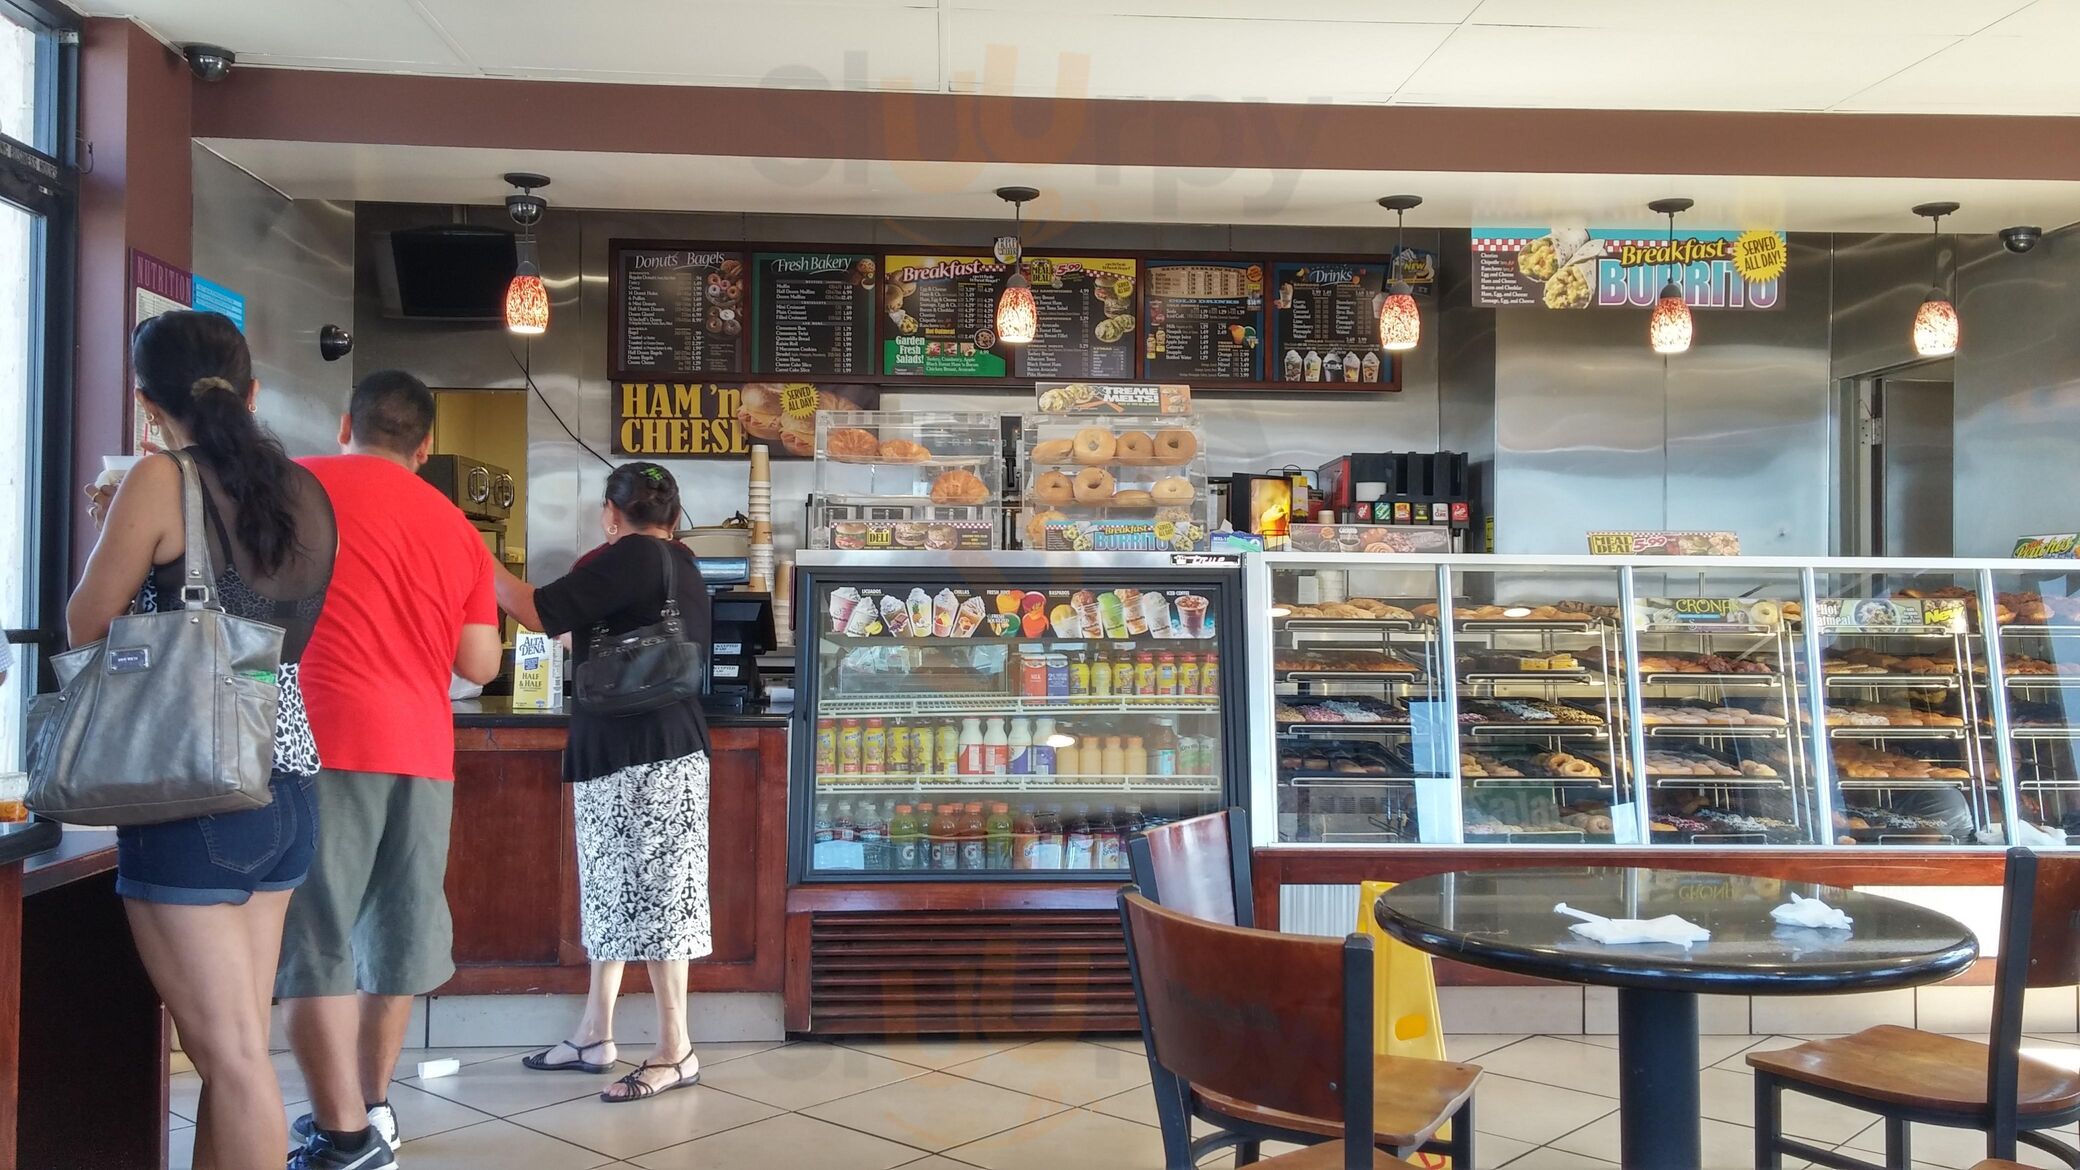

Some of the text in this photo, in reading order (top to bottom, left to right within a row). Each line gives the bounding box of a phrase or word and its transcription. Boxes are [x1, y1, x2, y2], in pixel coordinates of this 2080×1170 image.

[1622, 239, 1725, 266] Breakfast
[1743, 236, 1776, 256] SERVED
[635, 251, 725, 270] Donuts Bagels
[772, 254, 852, 272] Fresh Bakery
[1745, 250, 1782, 271] ALL DAY!
[903, 260, 980, 282] Breakfast
[1056, 263, 1081, 276] 5.99
[1314, 269, 1353, 283] Drinks
[137, 256, 191, 303] NUTRITION
[1599, 259, 1778, 308] BURRITO
[896, 336, 925, 346] Garden
[900, 345, 921, 355] Fresh
[896, 354, 924, 364] Salads!
[787, 387, 812, 402] SERVED
[1093, 386, 1158, 395] XTREME
[621, 384, 741, 418] HAM 'n
[788, 396, 815, 410] ALL DAY!
[1104, 395, 1159, 403] MELTS!
[620, 419, 750, 454] CHEESE
[1105, 525, 1147, 534] Breakfast
[870, 533, 889, 543] DELI
[1095, 532, 1168, 550] BURRITO
[1595, 536, 1631, 545] MEAL
[1597, 544, 1629, 553] DEAL
[1822, 604, 1837, 615] Hot
[1818, 616, 1851, 625] atmeal
[524, 637, 544, 647] ALTA
[519, 644, 546, 656] DENA
